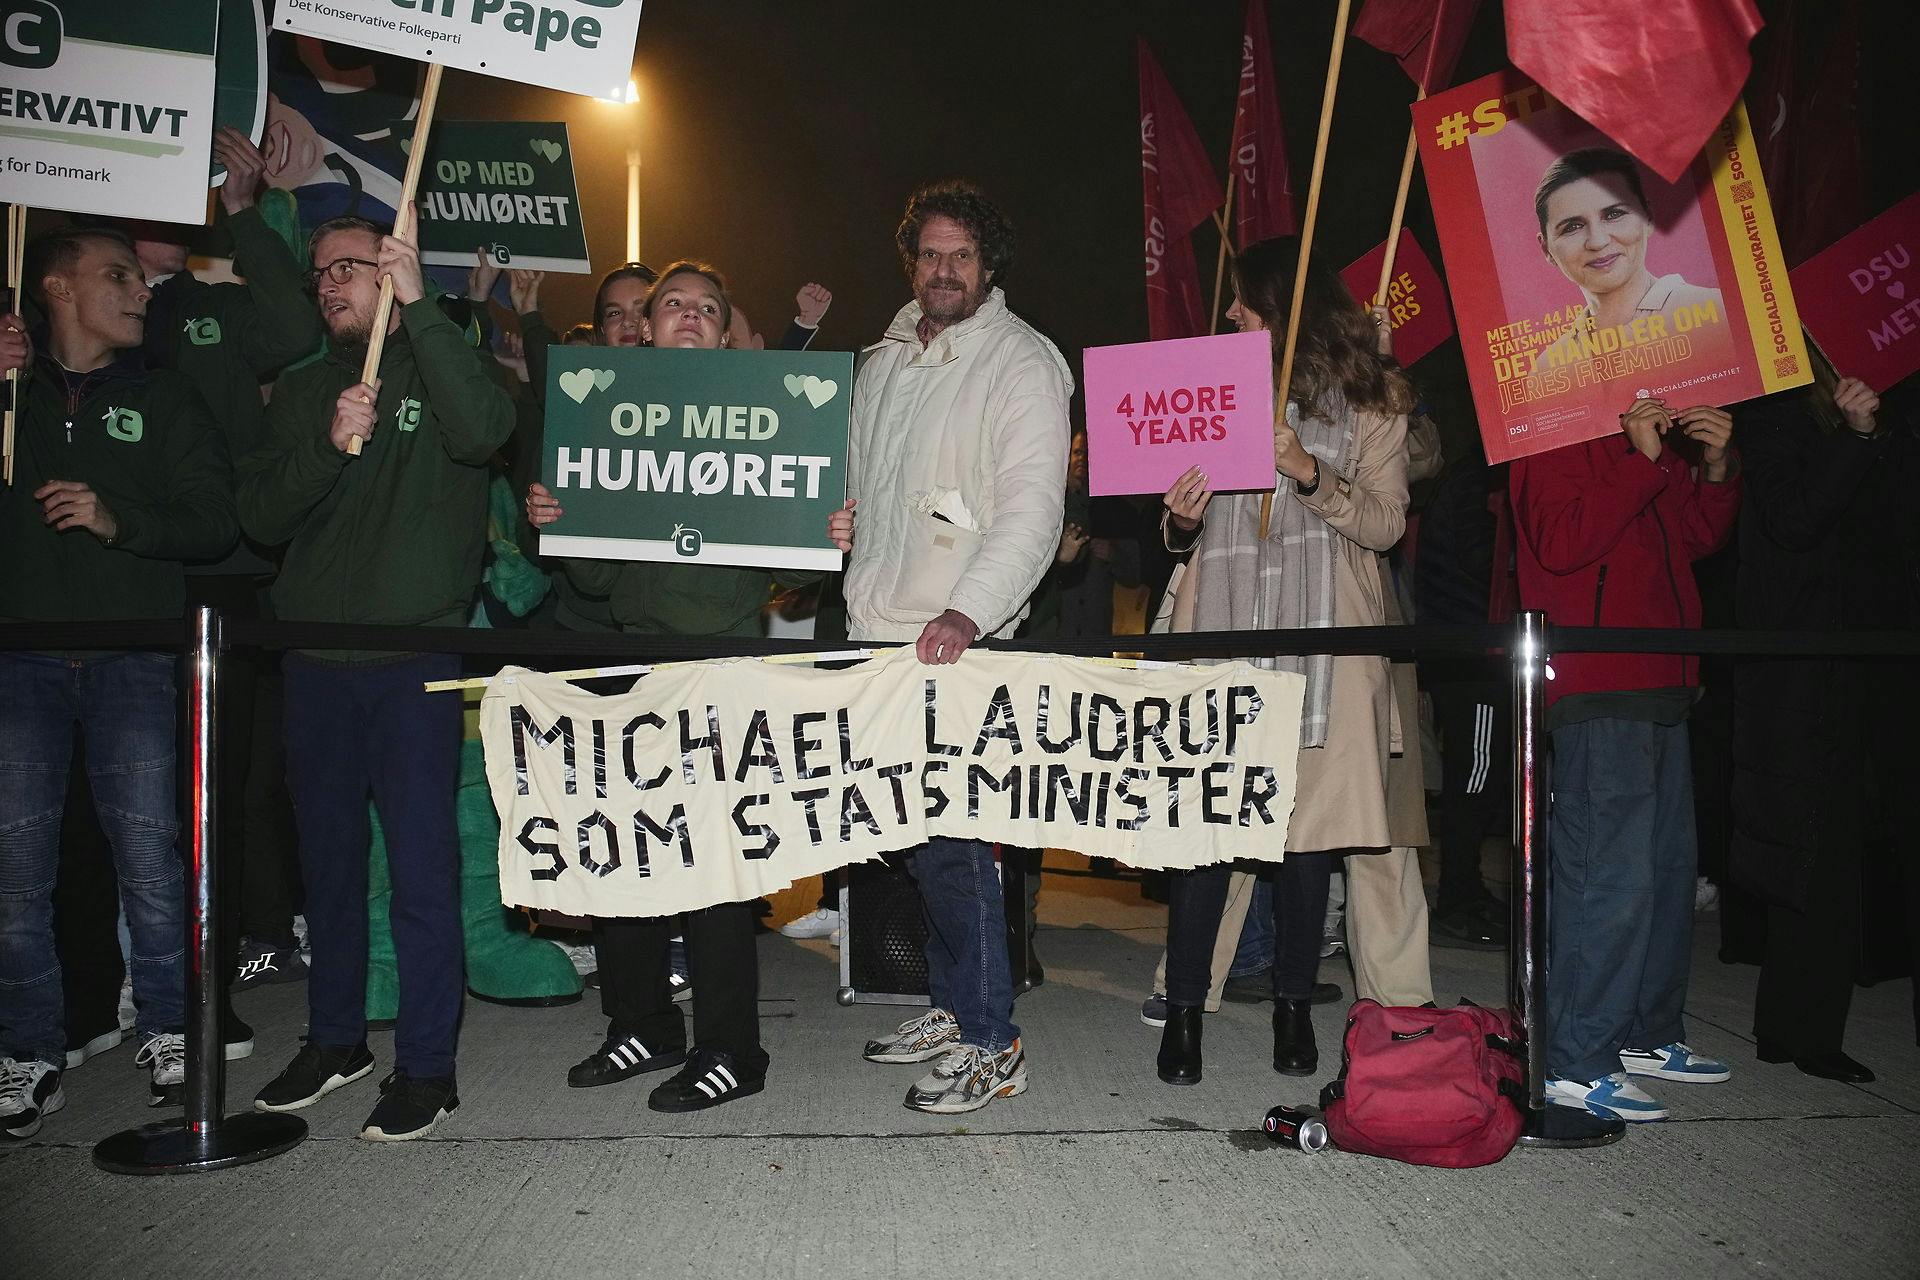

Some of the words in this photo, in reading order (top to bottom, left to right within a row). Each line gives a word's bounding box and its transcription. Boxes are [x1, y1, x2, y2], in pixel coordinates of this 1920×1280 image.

[5, 12, 42, 54] C
[289, 0, 312, 12] Det
[314, 4, 396, 30] Konservative
[399, 21, 462, 44] Folkeparti
[7, 157, 31, 173] for
[36, 161, 111, 182] Danmark
[436, 159, 472, 184] OP
[477, 161, 535, 186] MED
[419, 191, 570, 226] HUMØRET
[1740, 204, 1789, 354] SOCIALDEMOKRATIET
[1848, 243, 1911, 295] DSU
[1486, 318, 1533, 344] METTE
[1543, 311, 1562, 328] 44
[1493, 349, 1539, 383] DET
[1546, 312, 1668, 369] HANDLER
[1674, 300, 1721, 334] OM
[1498, 367, 1572, 415] JERES
[1574, 334, 1693, 387] FREMTID
[1652, 366, 1742, 396] SOCIALDEMOKRATIET
[1116, 393, 1135, 418] 4
[1143, 384, 1237, 417] MORE
[610, 402, 671, 437] OP
[682, 404, 780, 441] MED
[1127, 414, 1227, 446] YEARS
[1509, 424, 1529, 436] DSU
[556, 447, 831, 499] HUMØRET
[509, 704, 873, 799] MICHAEL
[924, 679, 1265, 764] LAUDRUP
[515, 803, 696, 882] SOM
